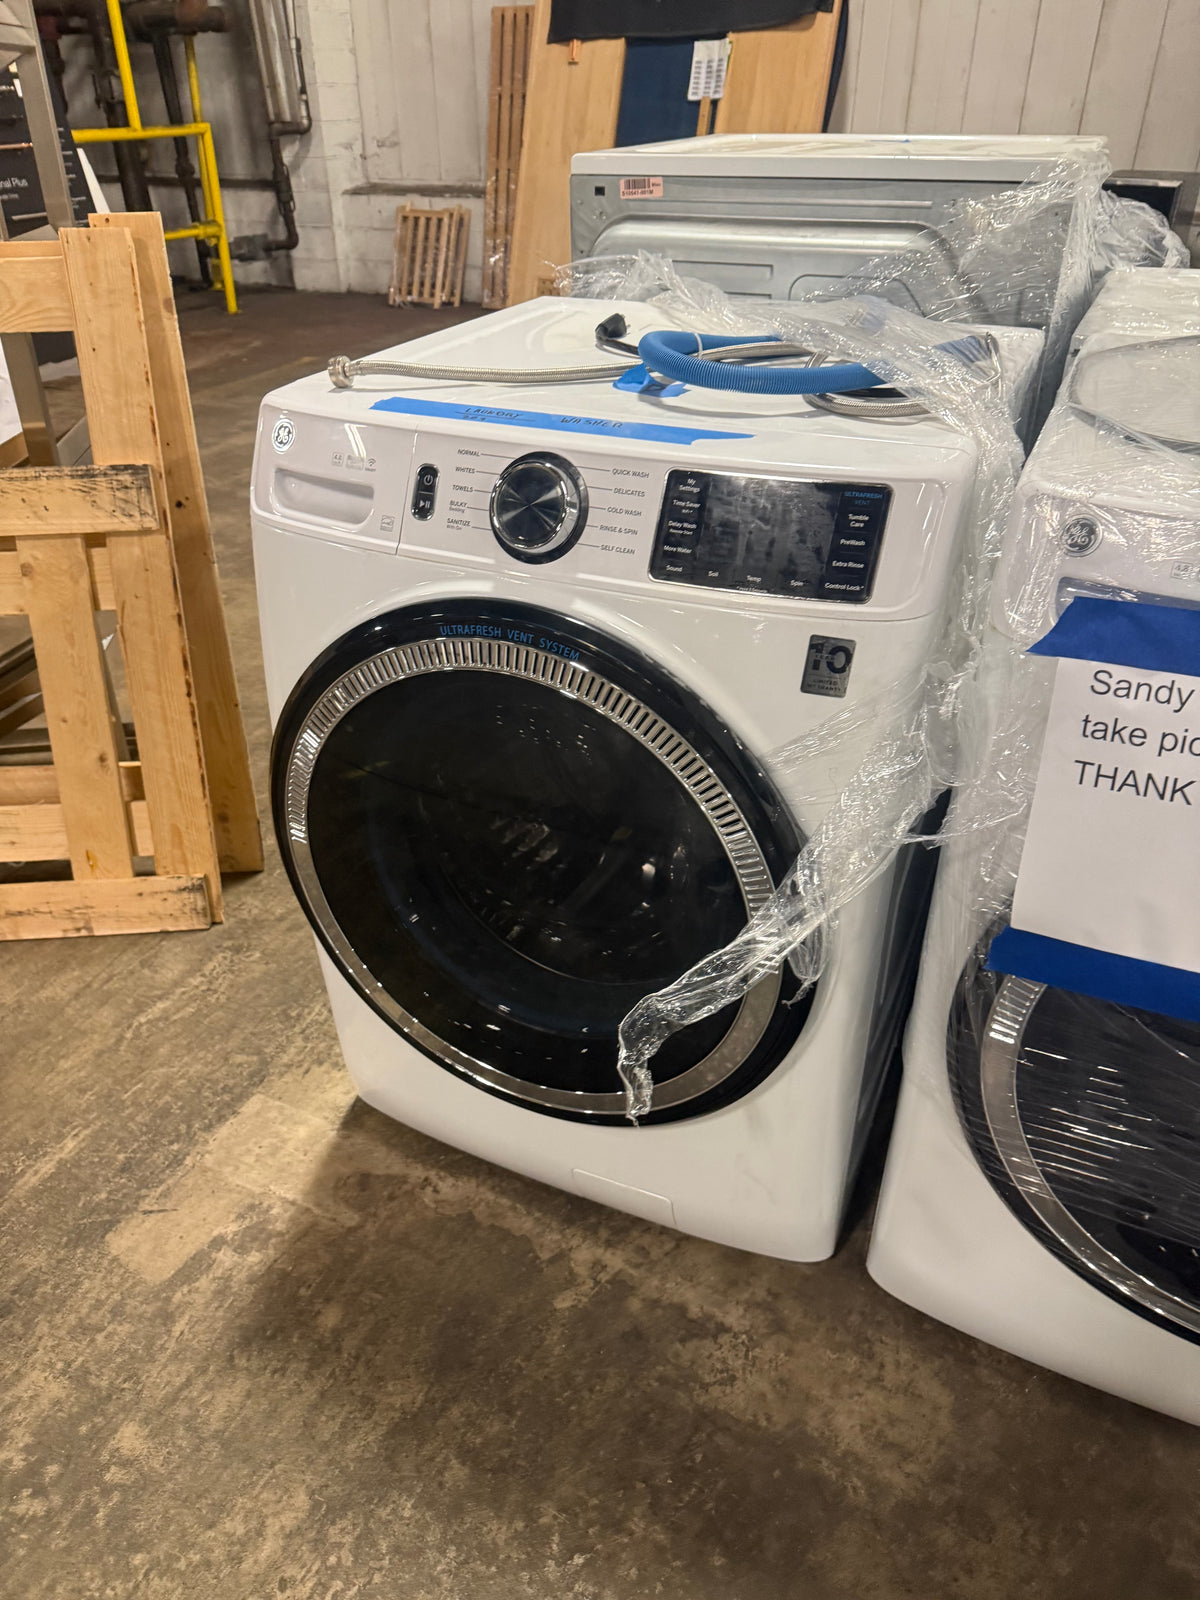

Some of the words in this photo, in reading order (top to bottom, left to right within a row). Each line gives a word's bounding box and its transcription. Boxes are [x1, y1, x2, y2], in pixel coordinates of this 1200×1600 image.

[560, 416, 623, 429] WASHER
[457, 448, 480, 457] NORMAL
[455, 466, 475, 474] WHITES
[612, 468, 631, 476] QUICK
[632, 470, 650, 478] WASH
[687, 478, 696, 486] My
[452, 484, 474, 492] TOWELS
[613, 487, 645, 497] DELICATES
[679, 484, 701, 493] Settings
[844, 491, 883, 499] ULTRAFRESH
[449, 500, 468, 508] BULKY
[607, 506, 624, 515] COLD
[624, 508, 642, 516] WASH
[848, 513, 870, 521] Tumble
[446, 517, 471, 527] SANITIZE
[668, 520, 682, 529] Delay
[682, 521, 697, 529] Wash
[600, 524, 617, 533] RINSE
[615, 546, 636, 555] CLEAN
[677, 546, 692, 554] Water
[666, 564, 683, 573] Sound
[847, 561, 865, 569] Rinse
[746, 575, 762, 583] Temp
[790, 579, 804, 587] Spin
[824, 582, 846, 590] Control
[440, 624, 502, 638] ULTRAFRESH
[507, 629, 535, 644] VENT
[539, 637, 580, 660] SYSTEM
[810, 643, 853, 674] 10
[1090, 669, 1195, 713] Sandy
[1082, 714, 1147, 747] take
[1074, 759, 1197, 806] THANK
